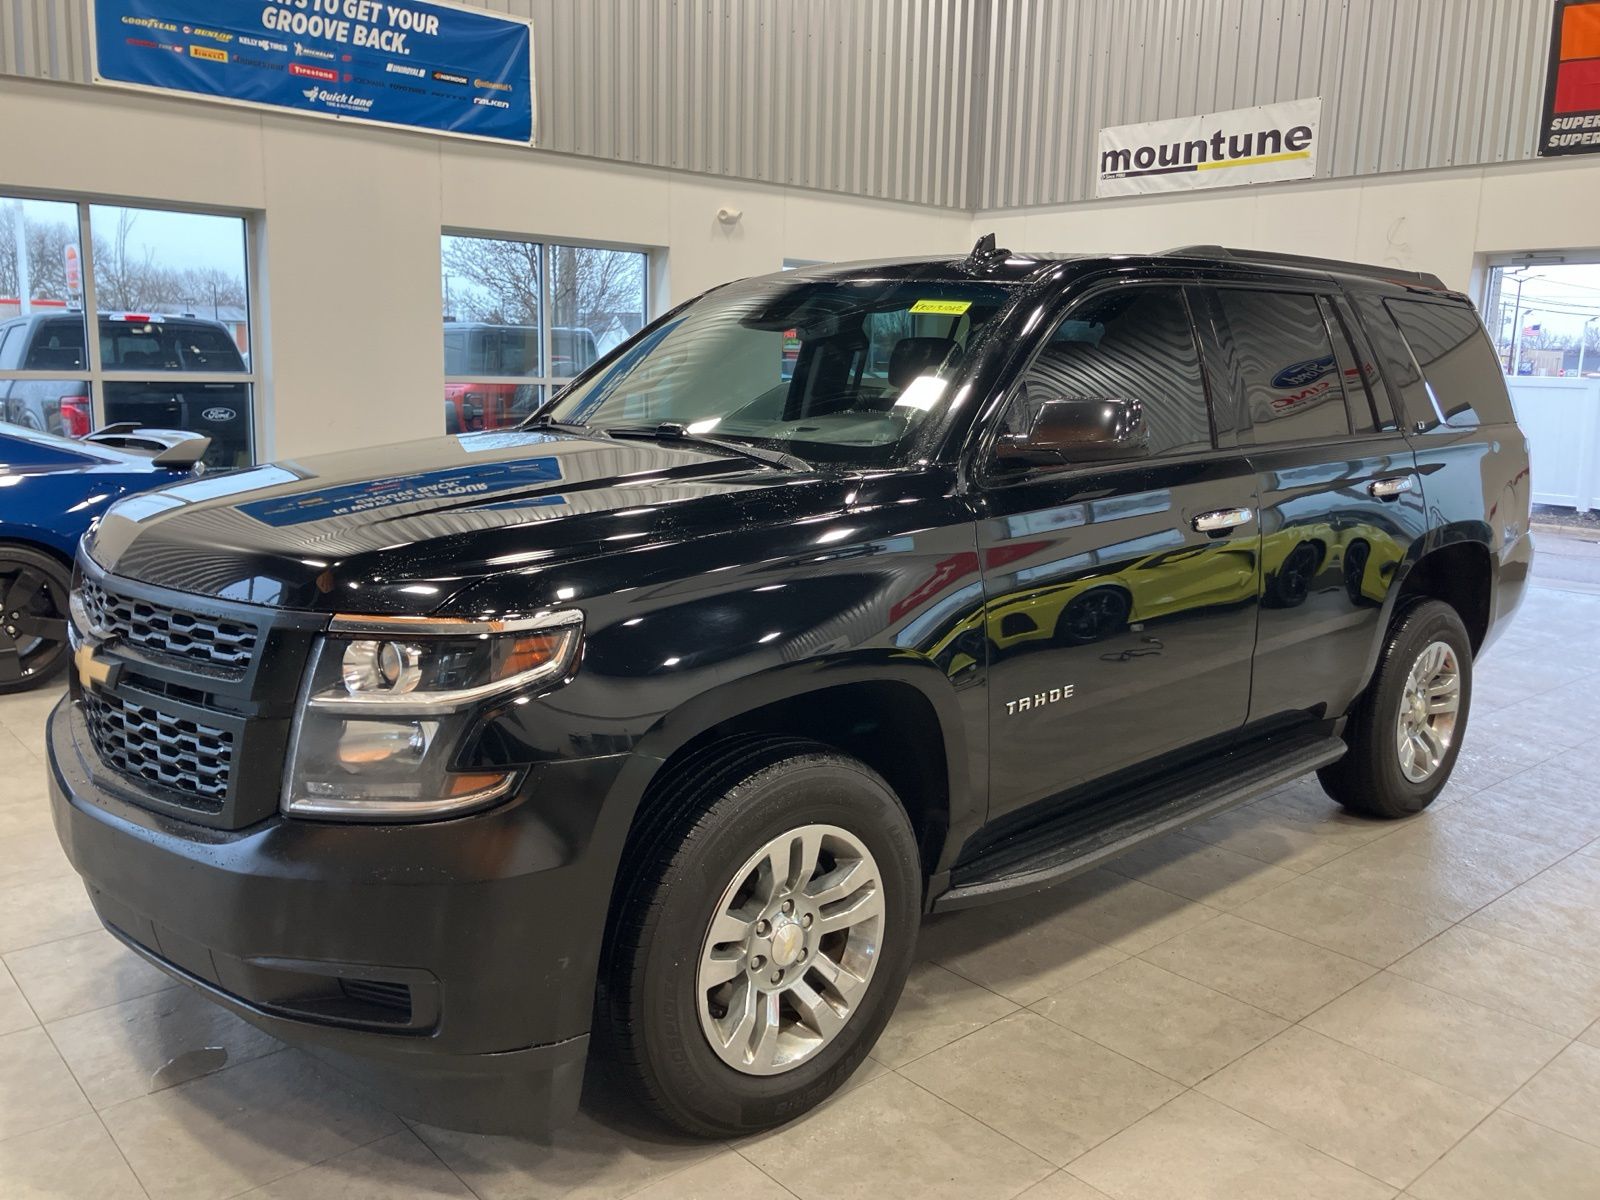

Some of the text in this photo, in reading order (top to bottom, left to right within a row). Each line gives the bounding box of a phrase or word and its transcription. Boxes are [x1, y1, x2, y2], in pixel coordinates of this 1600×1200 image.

[343, 0, 383, 23] GET
[387, 6, 440, 36] YOUR
[121, 16, 176, 32] GOODYEAR
[194, 28, 233, 42] DUNLOP
[261, 6, 410, 55] GROOVE BACK.
[319, 90, 374, 107] Quick Lane
[473, 97, 510, 109] FALKEN
[1551, 115, 1600, 130] SUPER
[1101, 125, 1312, 172] mountune
[1548, 132, 1600, 147] SUPER
[208, 408, 230, 419] Ford
[1006, 684, 1074, 715] TAHOE
